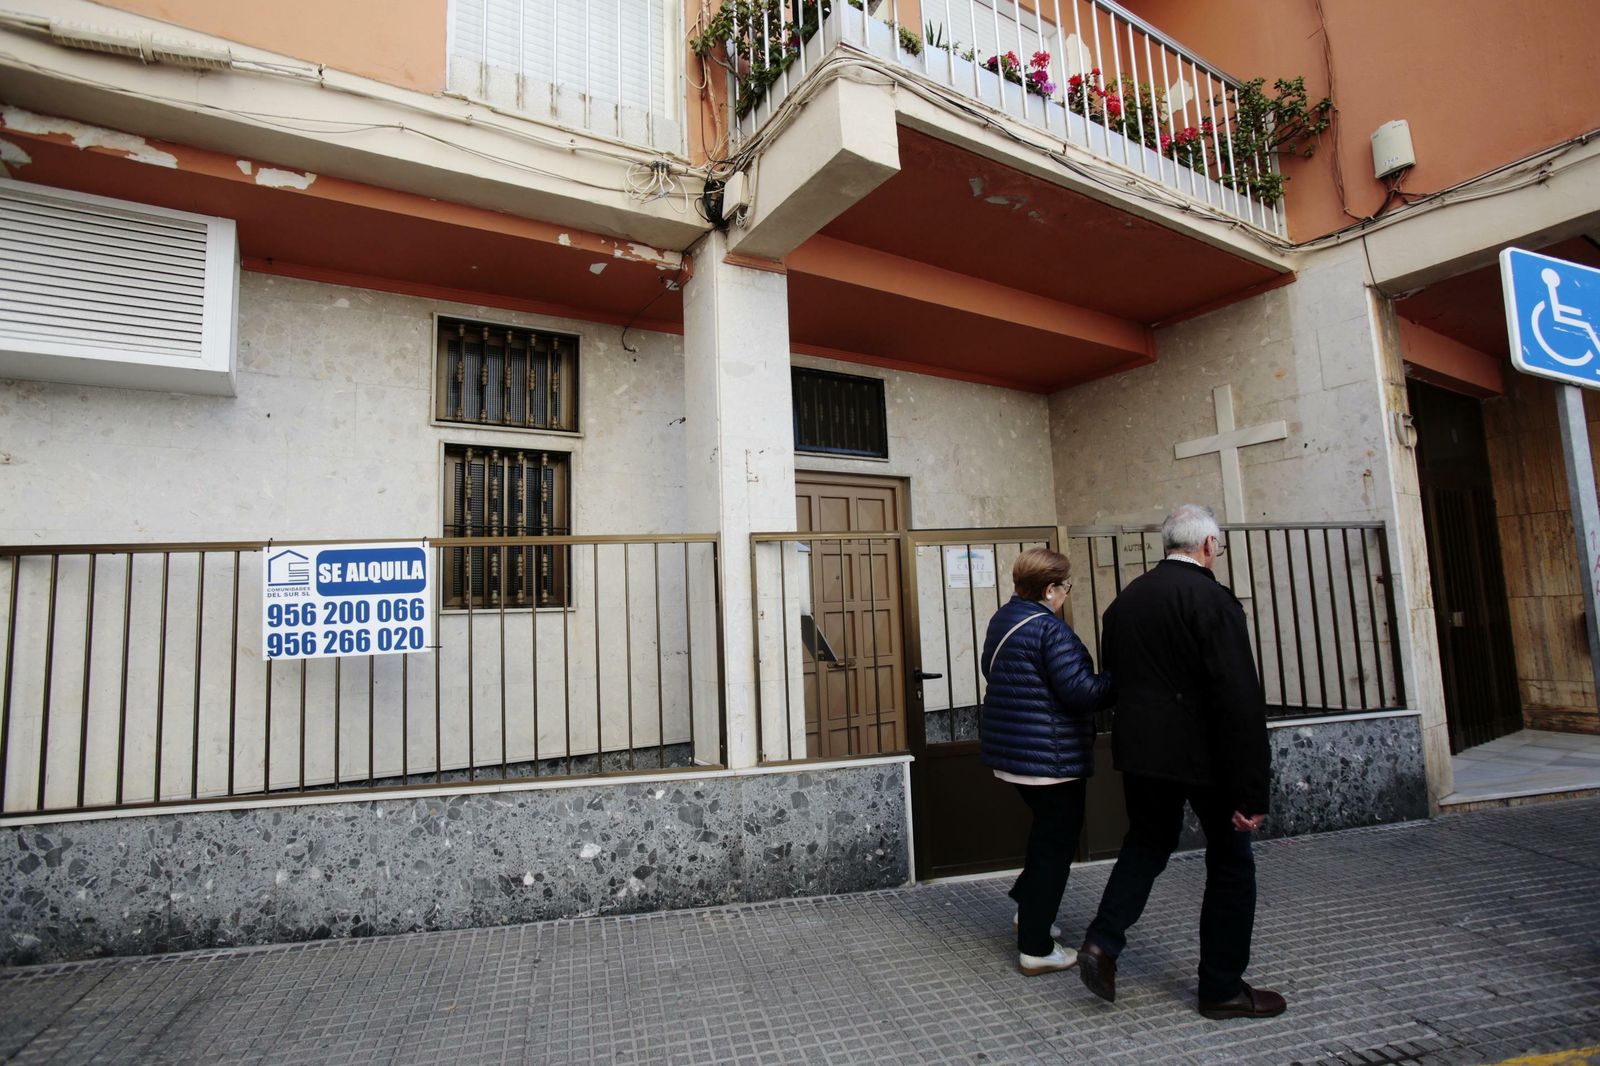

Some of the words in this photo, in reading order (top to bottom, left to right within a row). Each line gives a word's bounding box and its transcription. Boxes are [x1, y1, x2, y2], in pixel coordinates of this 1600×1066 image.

[318, 562, 342, 584] SE
[345, 560, 425, 584] ALQUILA
[267, 602, 317, 628] 956
[323, 600, 370, 625] 200
[377, 598, 425, 622] 066
[267, 631, 317, 657] 956
[323, 628, 371, 654] 266
[377, 626, 425, 651] 020
